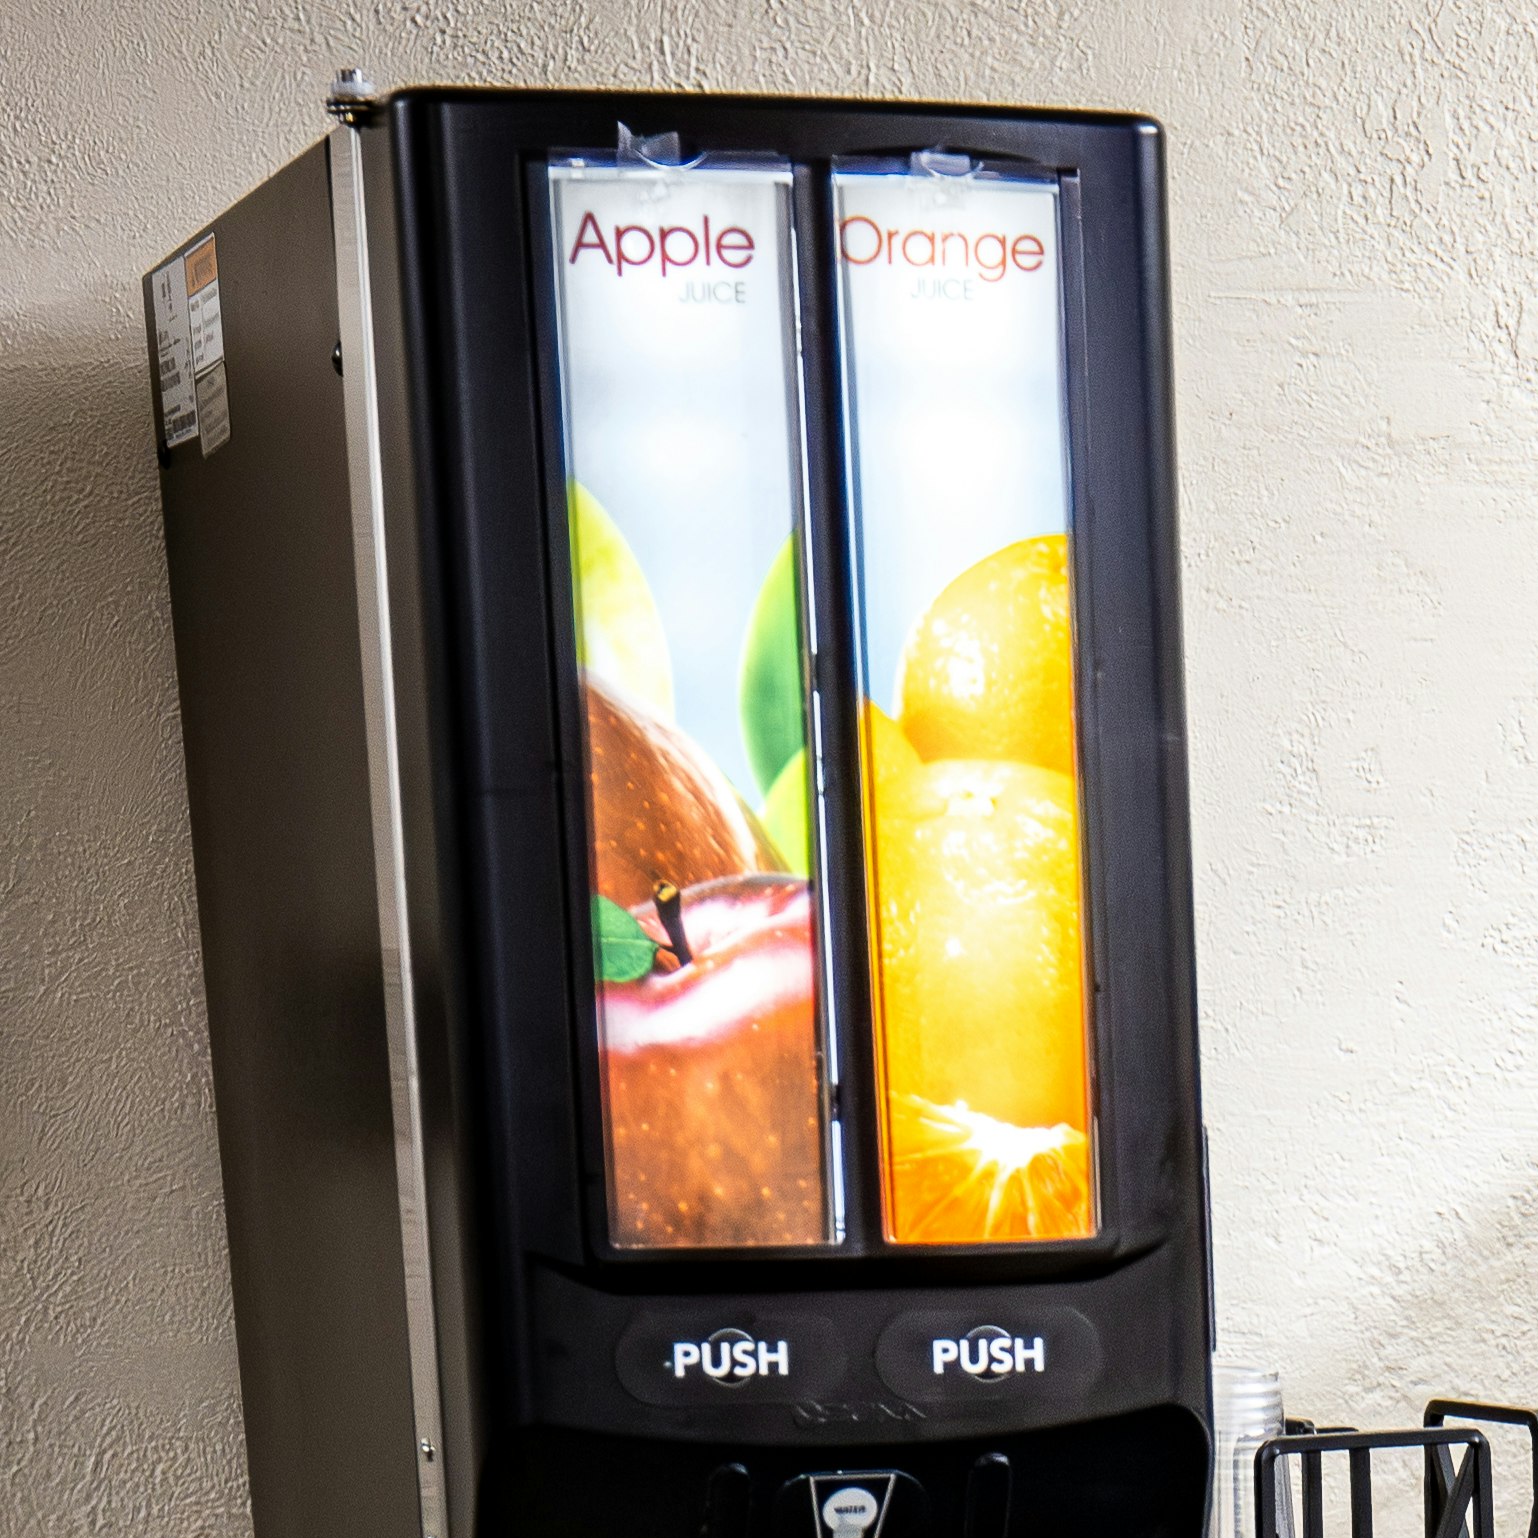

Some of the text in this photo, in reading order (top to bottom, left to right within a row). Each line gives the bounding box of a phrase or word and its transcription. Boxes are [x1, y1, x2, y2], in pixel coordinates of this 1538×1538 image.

[569, 211, 755, 277] Apple
[838, 215, 1045, 282] Orange
[679, 281, 747, 304] JUICE
[911, 278, 975, 300] JUICE
[672, 1340, 789, 1379] PUSH
[932, 1337, 1045, 1375] PUSH
